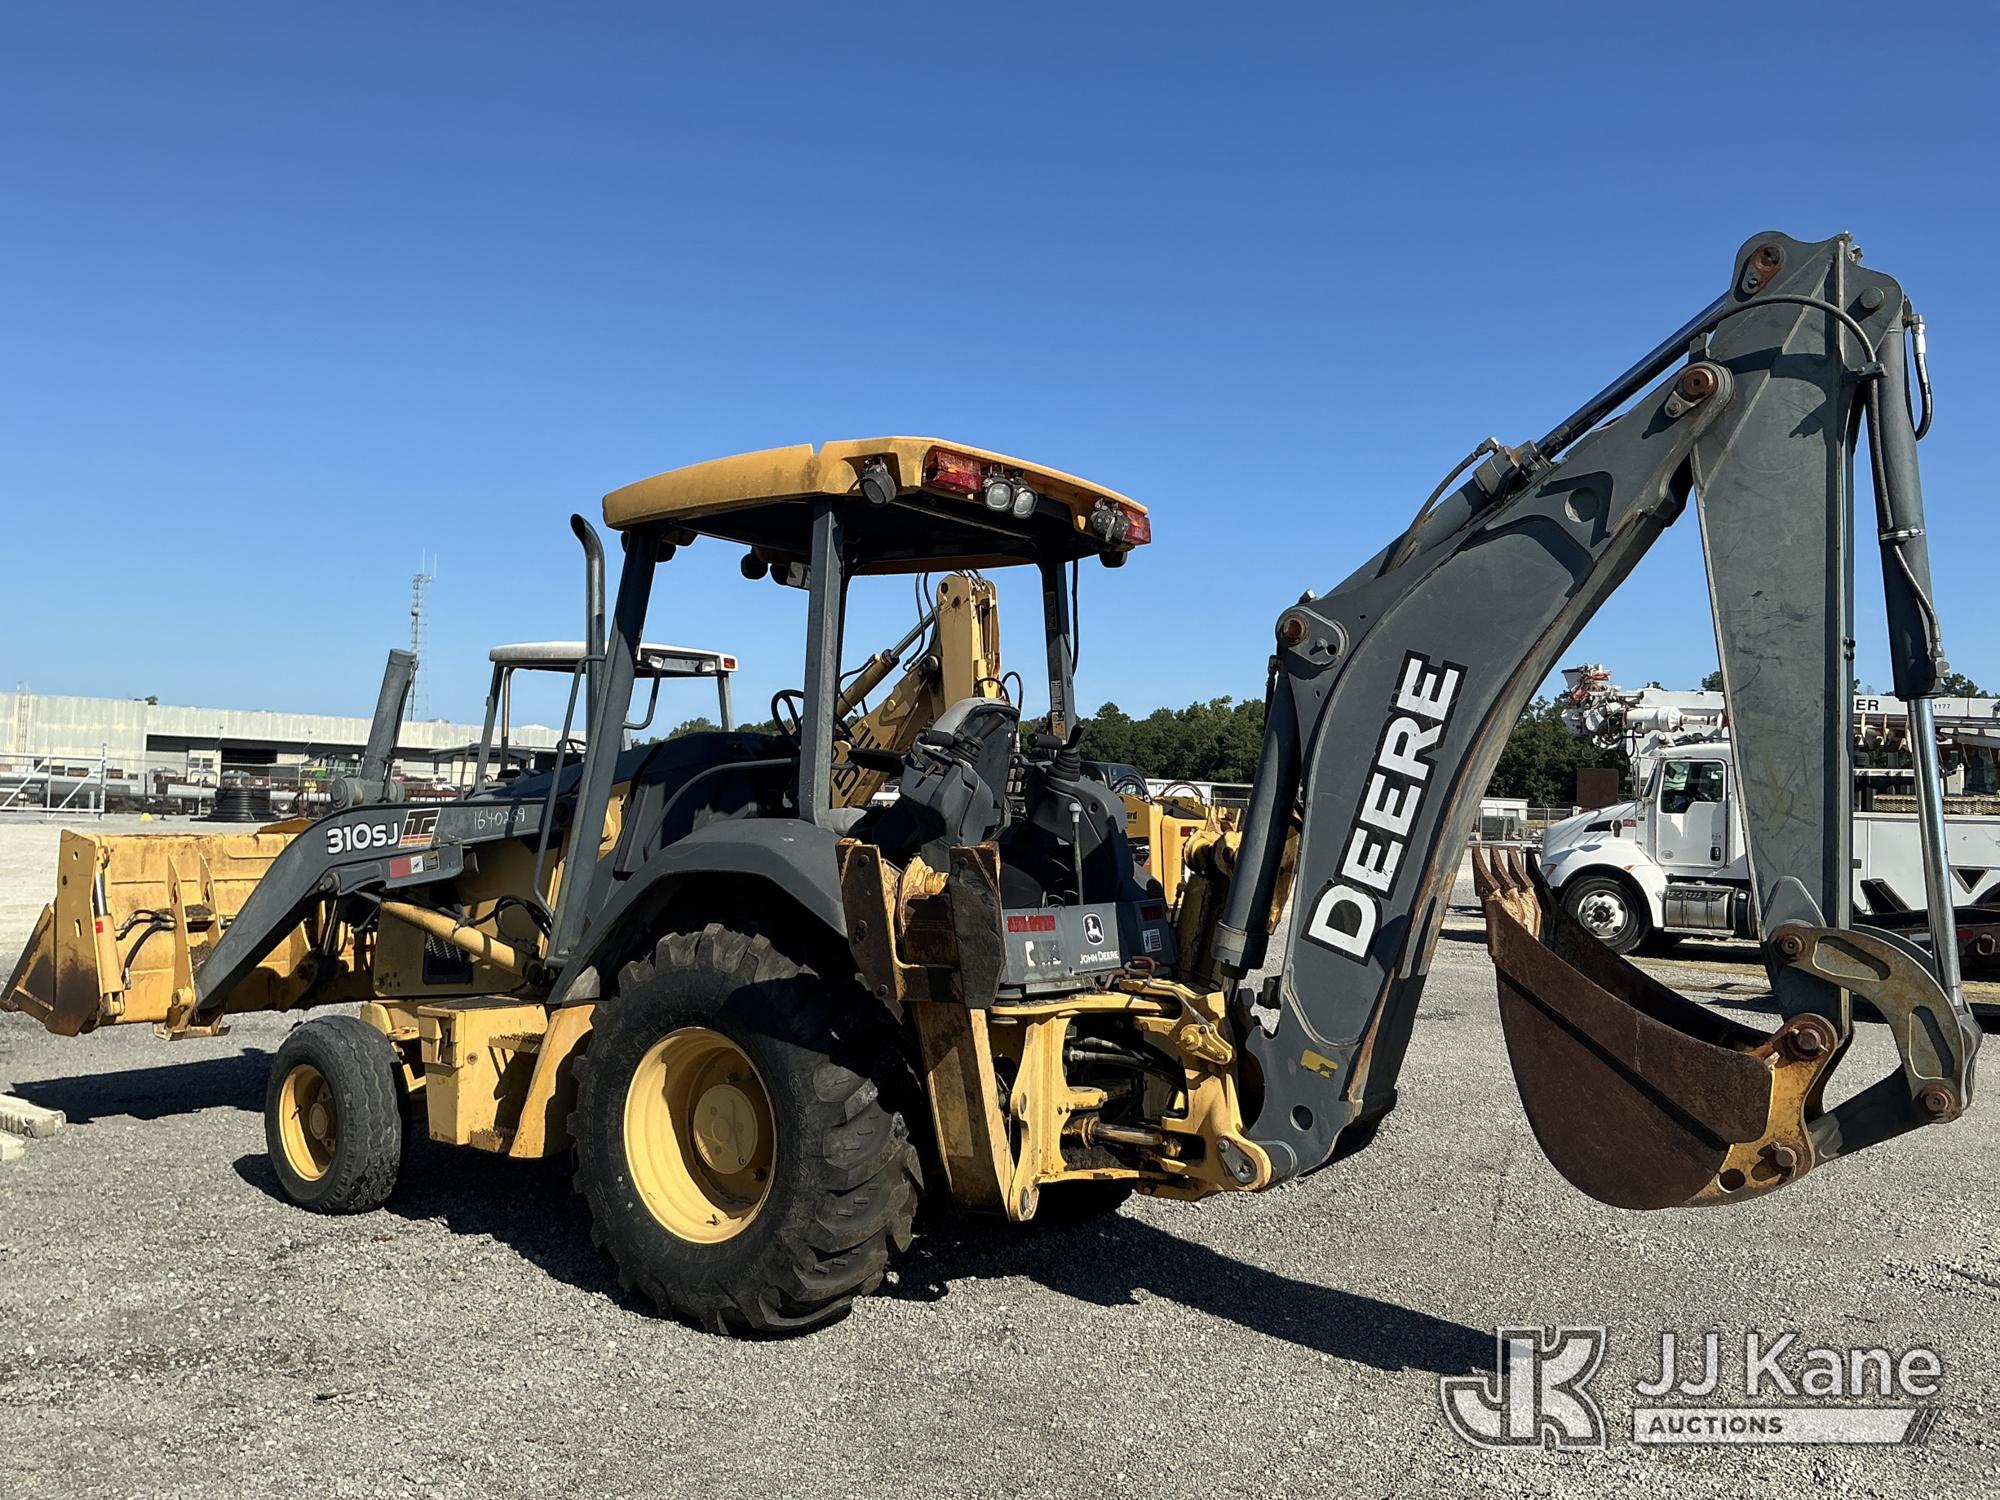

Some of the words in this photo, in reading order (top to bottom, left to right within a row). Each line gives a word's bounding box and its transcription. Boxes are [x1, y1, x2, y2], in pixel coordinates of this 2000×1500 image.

[473, 807, 526, 831] 1640269
[1307, 657, 1461, 959] DEERE
[326, 822, 399, 855] 310SJ
[1079, 953, 1098, 964] JOHN
